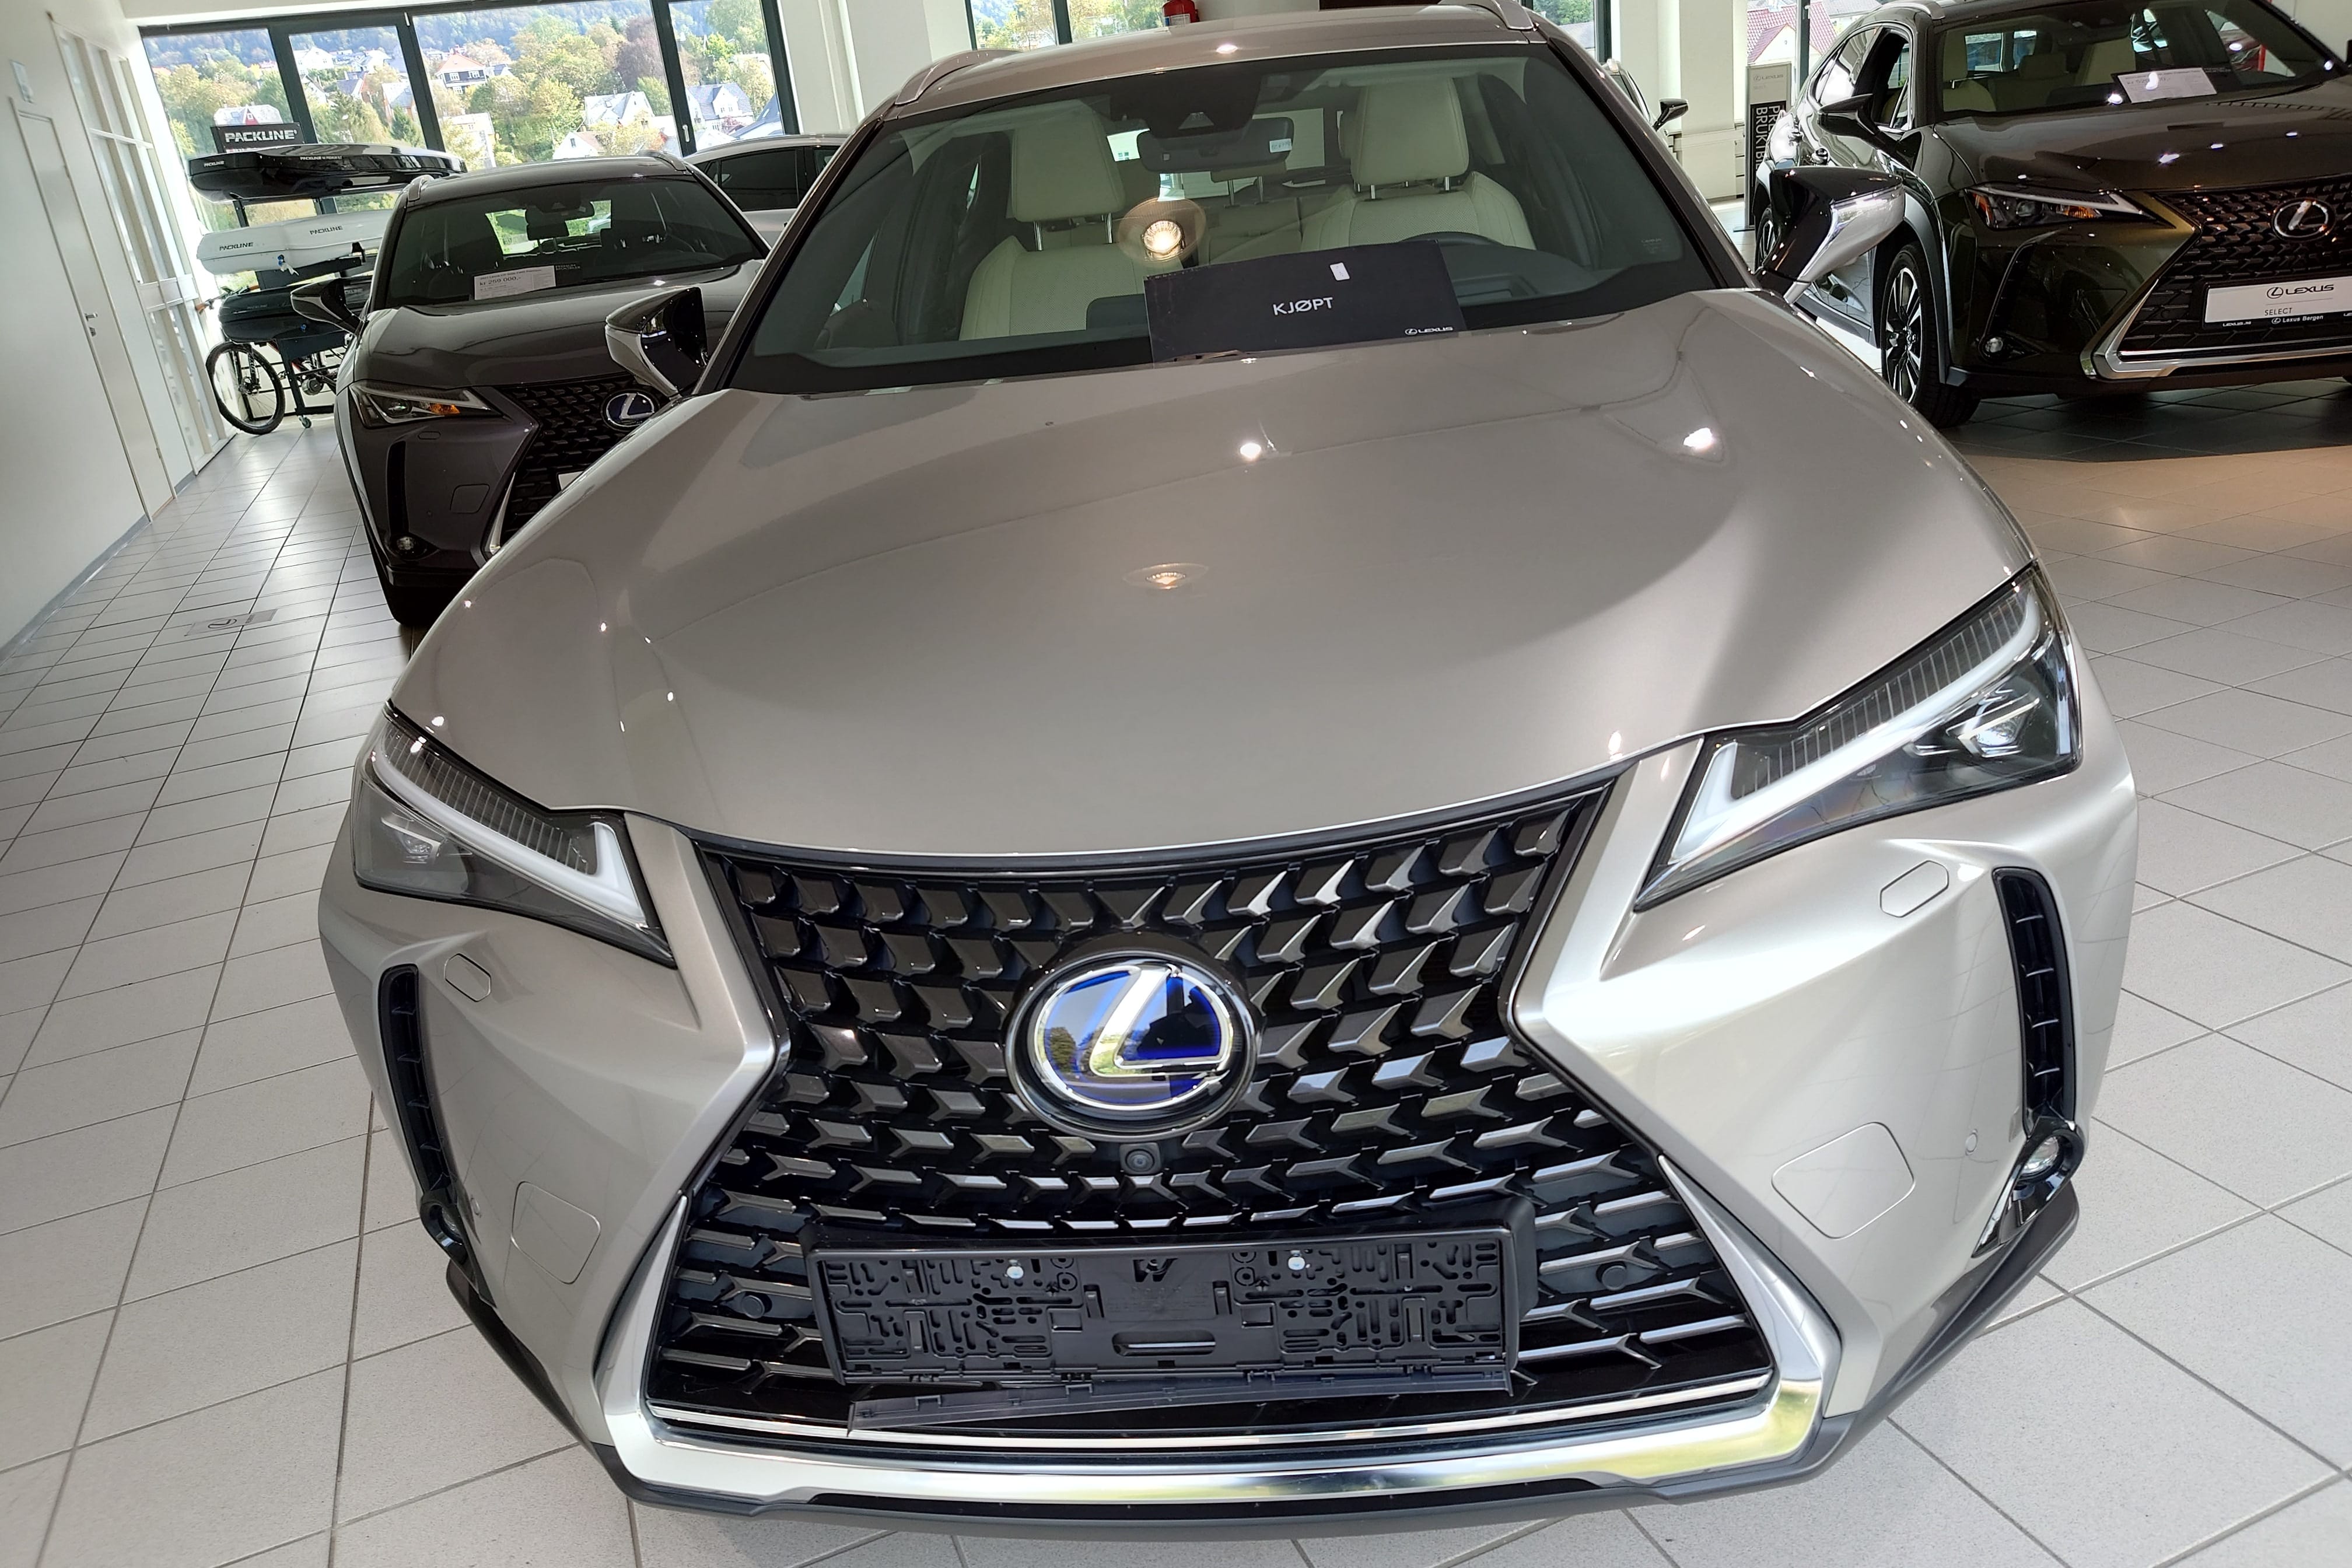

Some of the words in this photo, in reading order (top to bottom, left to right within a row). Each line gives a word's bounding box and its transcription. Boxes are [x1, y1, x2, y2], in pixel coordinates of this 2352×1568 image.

[224, 130, 296, 144] PACKLINE
[309, 225, 344, 235] PACKLINE
[219, 242, 254, 251] PACKLINE
[2286, 284, 2334, 295] LEXUS
[1273, 297, 1333, 316] KJØPT
[2264, 307, 2292, 316] SELECT
